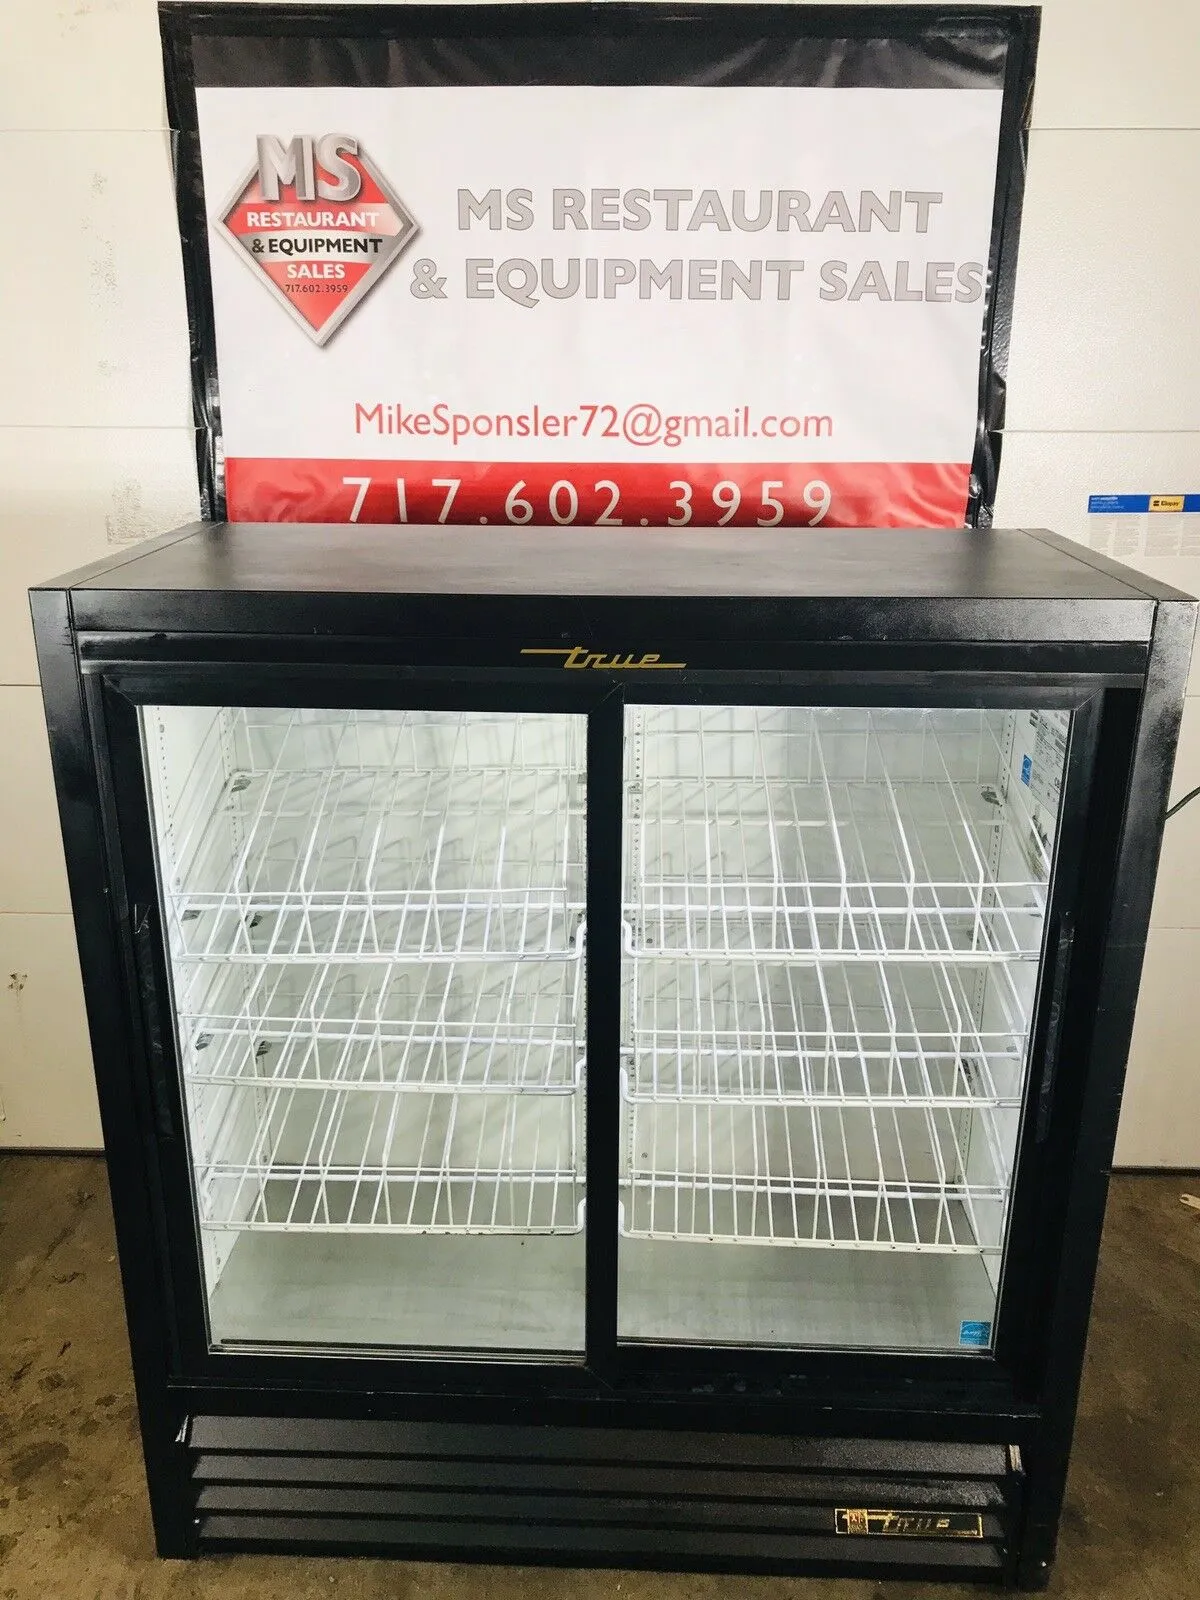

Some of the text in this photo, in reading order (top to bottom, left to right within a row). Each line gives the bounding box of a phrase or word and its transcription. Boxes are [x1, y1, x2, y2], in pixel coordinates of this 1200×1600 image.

[256, 132, 363, 202] MS
[246, 211, 380, 228] RESTAURANT
[457, 188, 944, 233] MS RESTAURANT
[252, 237, 384, 257] & EQUIPMENT
[286, 263, 346, 280] SALES
[284, 283, 349, 294] 717.602.3959
[409, 258, 984, 309] & EQUIPMENT SALES
[354, 402, 834, 448] MikeSponsler72@gmail.com
[520, 646, 687, 669] true
